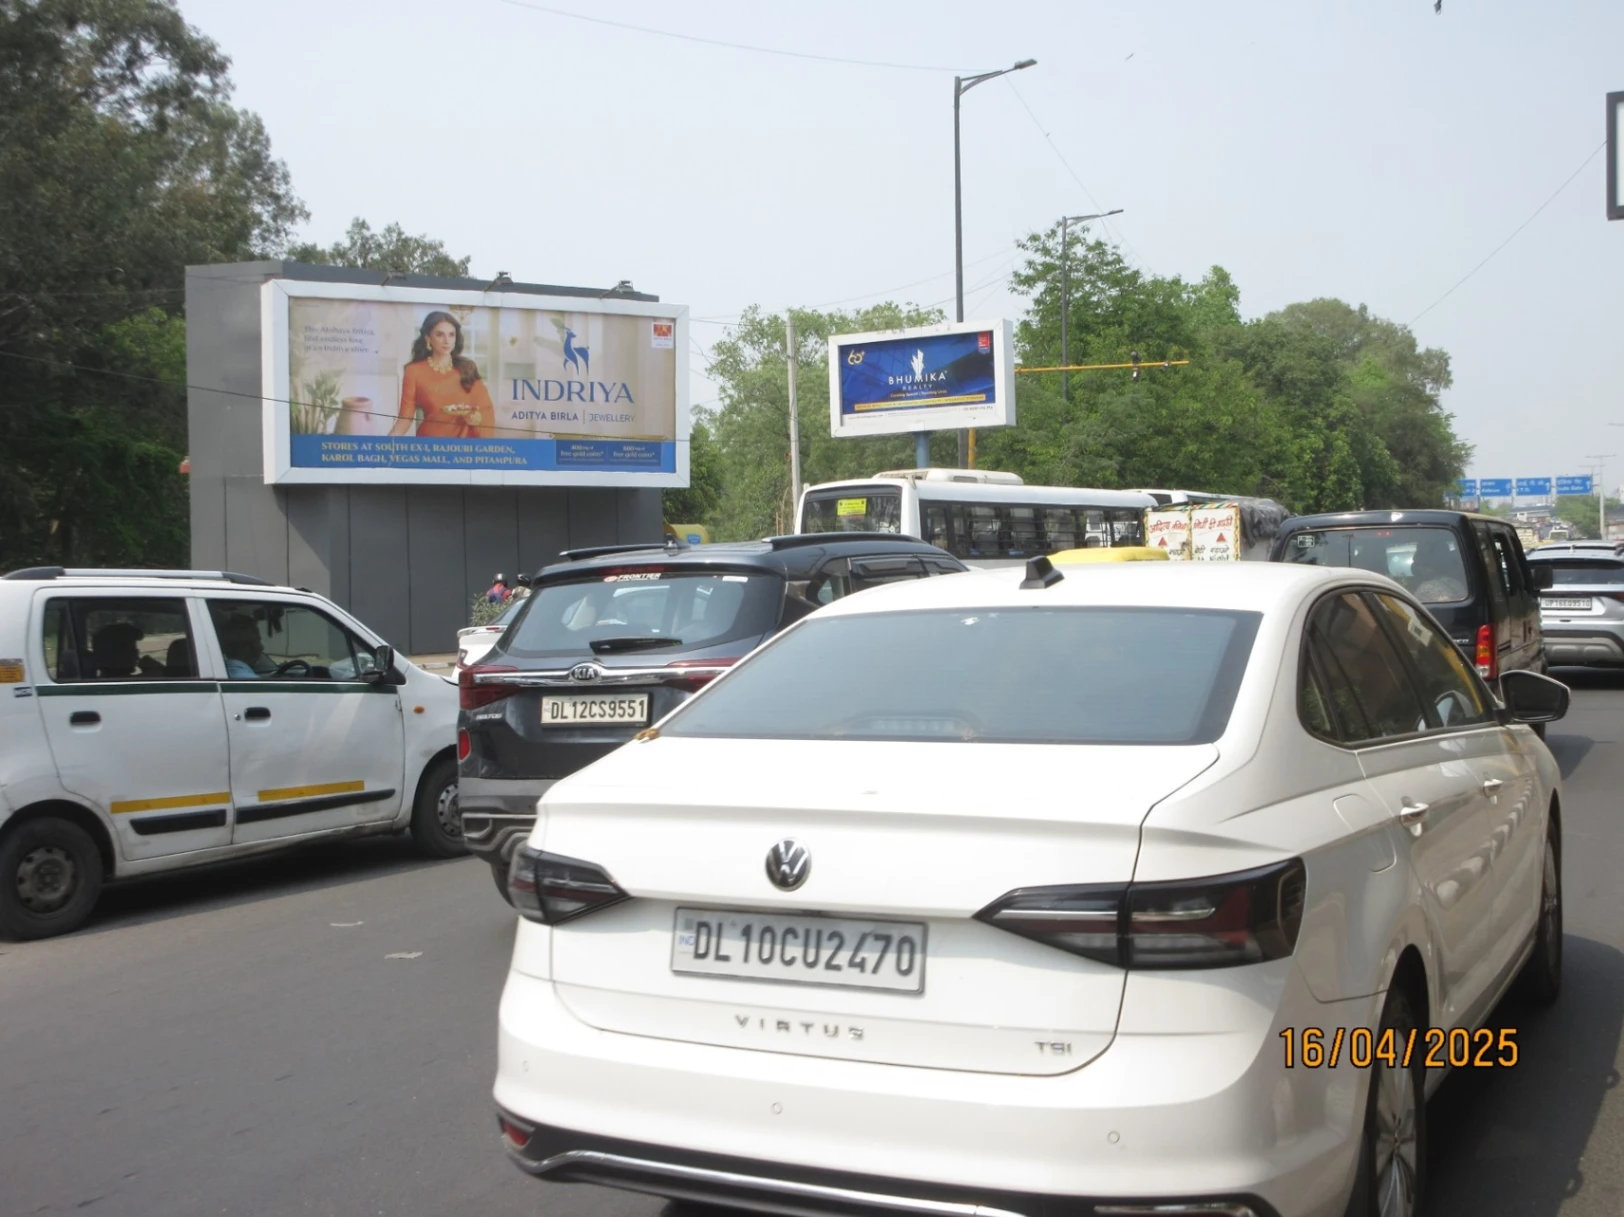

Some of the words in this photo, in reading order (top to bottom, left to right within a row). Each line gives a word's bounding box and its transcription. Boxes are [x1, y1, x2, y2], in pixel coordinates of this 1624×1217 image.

[888, 371, 946, 385] BHUMIKA
[512, 378, 635, 404] INDRIYA
[511, 410, 547, 421] ADITYA
[550, 411, 579, 421] BIRLA
[589, 413, 636, 423] JEWELLERY
[321, 442, 358, 450] STORES
[361, 442, 373, 450] AT
[375, 442, 408, 451] SOUTH
[433, 444, 473, 453] RAJOURI
[322, 453, 354, 462] KAROL
[389, 454, 420, 463] VEGAS
[453, 456, 473, 464] AND
[475, 456, 528, 465] PITAMPURA
[617, 572, 662, 581] FRONTIER
[574, 667, 595, 679] KIA
[551, 699, 645, 719] DL12CS9551
[693, 920, 917, 978] DL10CU2470
[735, 1013, 865, 1042] VIRTUS
[1034, 1041, 1072, 1056] TSI
